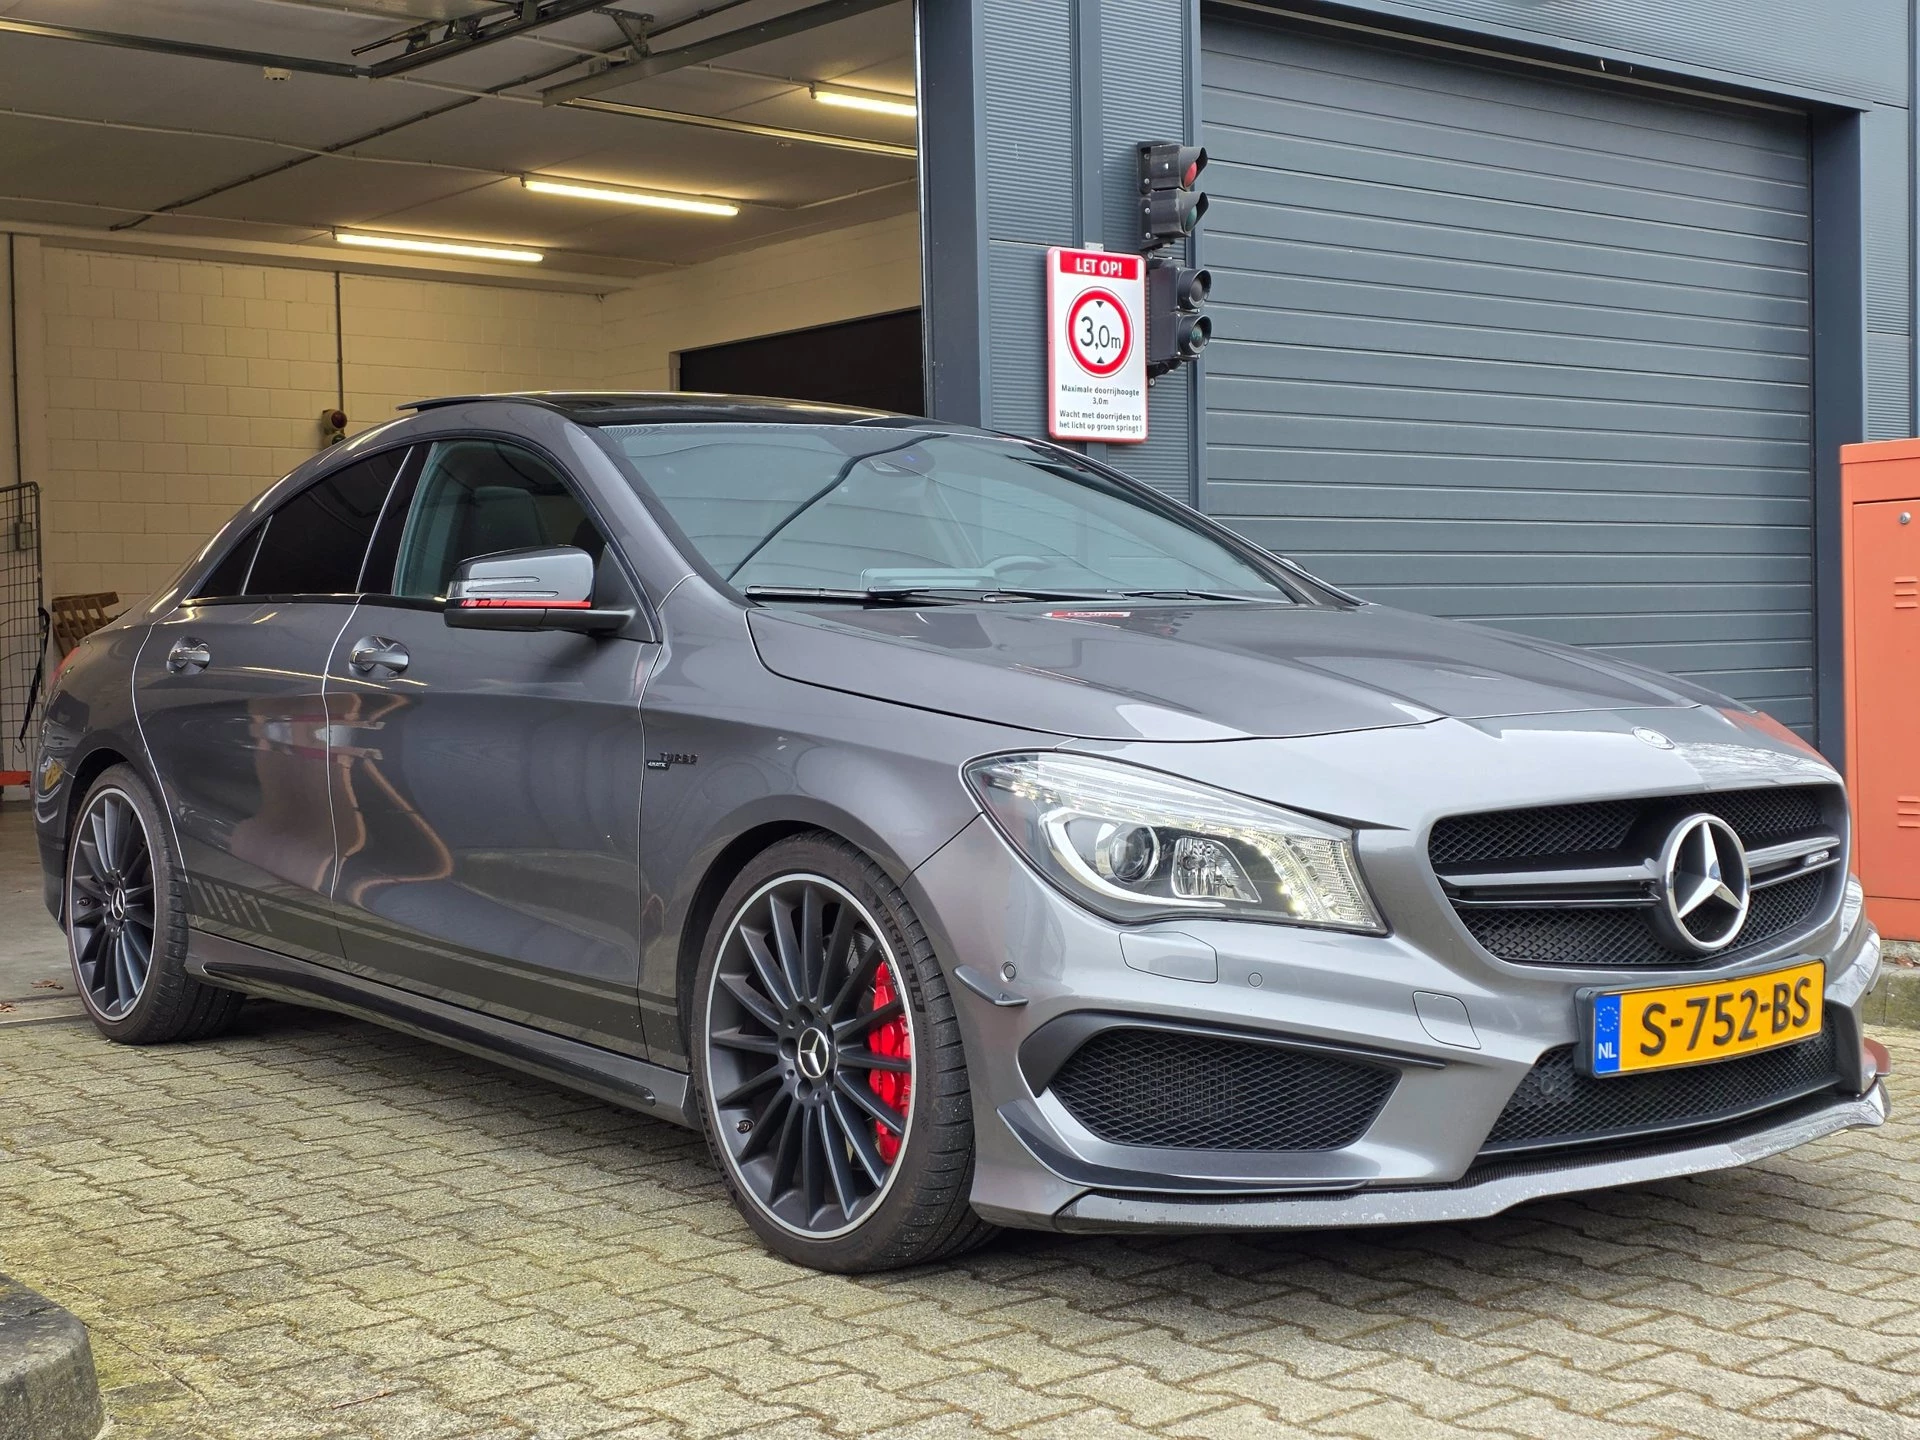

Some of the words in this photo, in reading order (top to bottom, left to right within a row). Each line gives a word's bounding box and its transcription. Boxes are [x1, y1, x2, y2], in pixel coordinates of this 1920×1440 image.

[1076, 257, 1098, 273] LET
[1100, 261, 1123, 277] OP!
[1080, 315, 1121, 350] 3,0m
[1061, 384, 1093, 394] Maximale
[1094, 386, 1140, 398] doorrijhoogte
[1092, 397, 1109, 405] 3,0m
[1059, 410, 1080, 419] Wacht
[1096, 412, 1130, 422] doorrijden
[1059, 421, 1070, 429] het
[1071, 421, 1086, 429] licht
[1087, 423, 1095, 431] op
[1116, 424, 1139, 433] springt
[1639, 976, 1811, 1057] S-752-BS
[1598, 1042, 1617, 1060] NL
